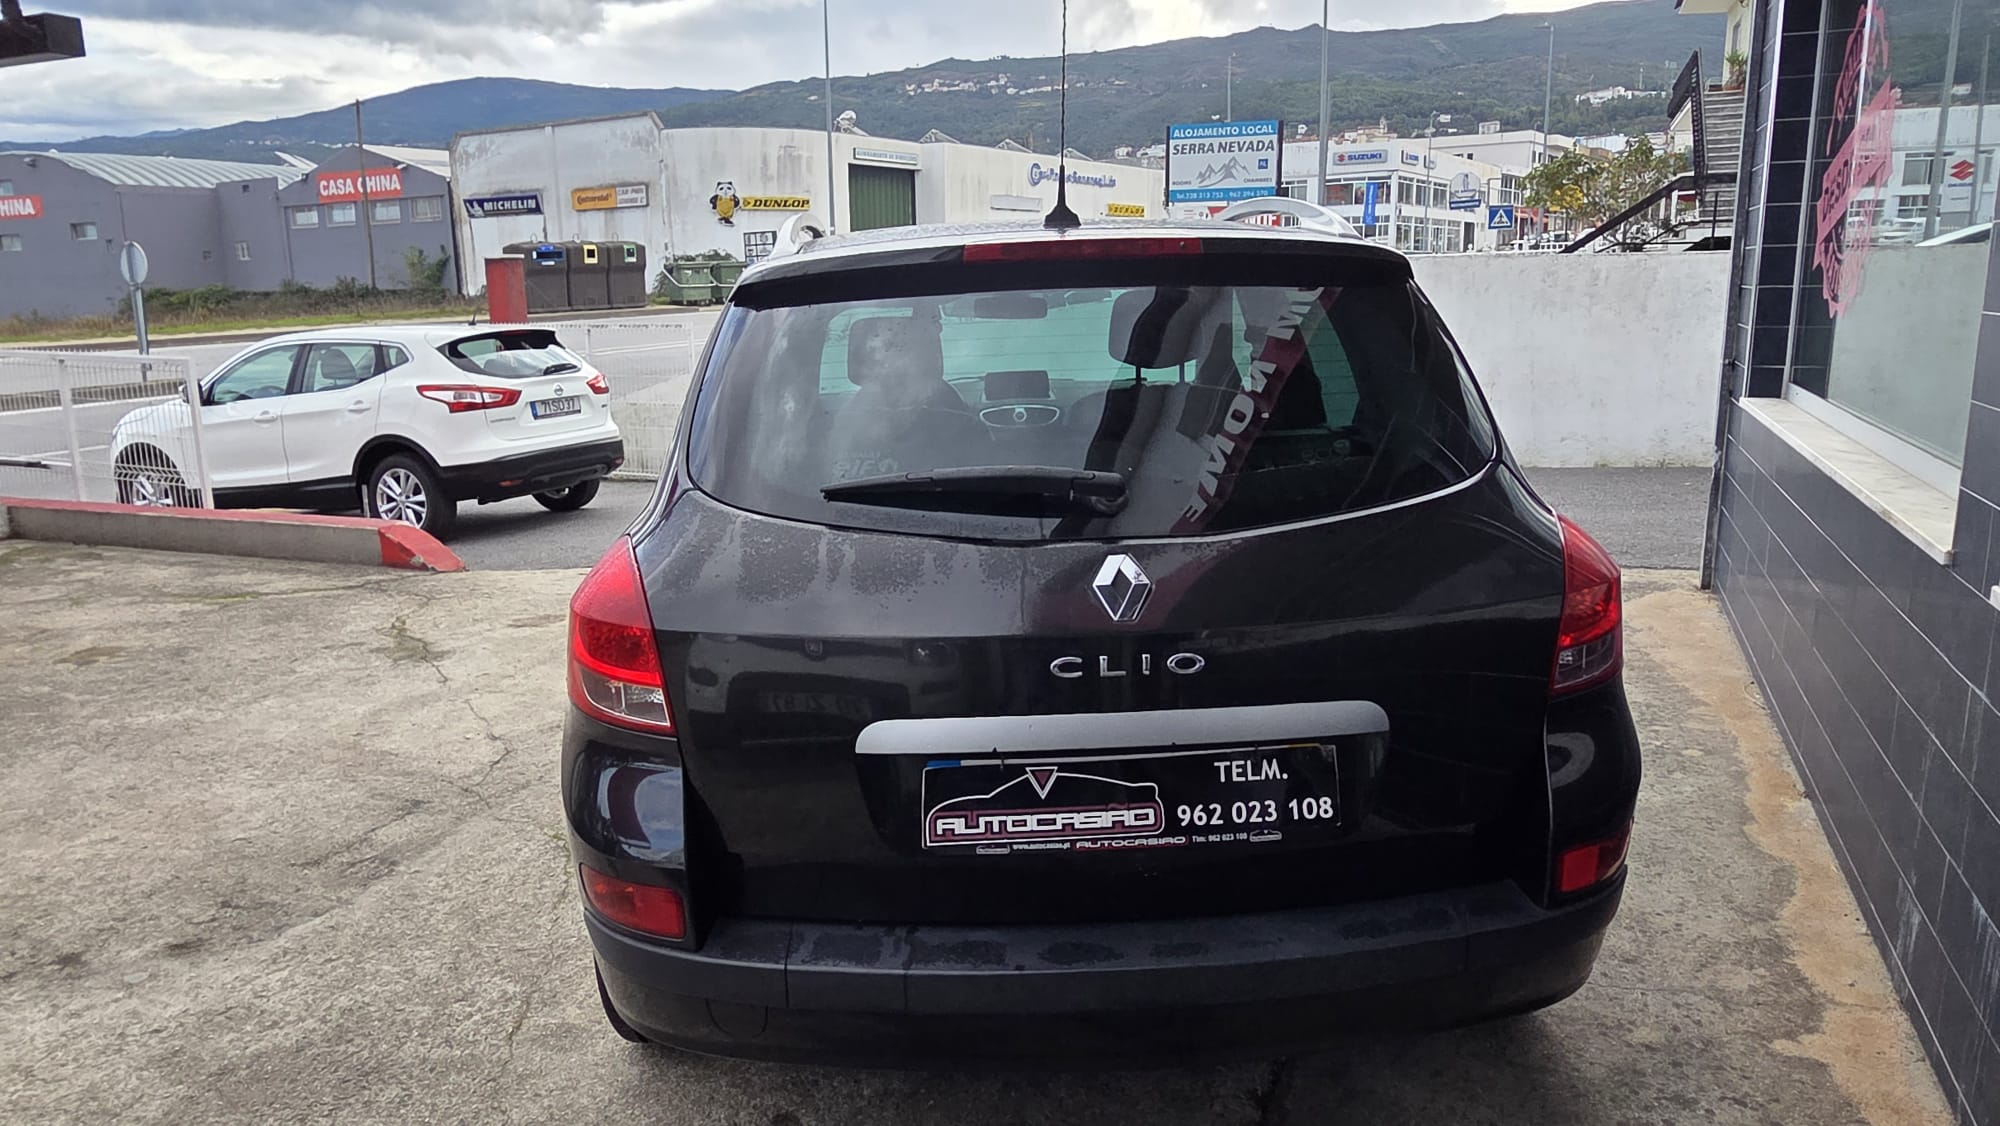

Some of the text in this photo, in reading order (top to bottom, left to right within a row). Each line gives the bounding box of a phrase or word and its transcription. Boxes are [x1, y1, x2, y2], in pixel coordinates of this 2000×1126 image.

[1173, 124, 1274, 138] ALOJAMENTO LOCAL
[1172, 140, 1275, 155] SERRA NEVADA
[1347, 153, 1382, 161] SUZUKI
[319, 178, 355, 196] CASA
[483, 199, 537, 211] MICHELIN
[752, 199, 810, 208] DUNLOP
[1050, 652, 1206, 678] CLIO
[1213, 758, 1289, 783] TELM.
[1176, 797, 1334, 827] 962 023 108
